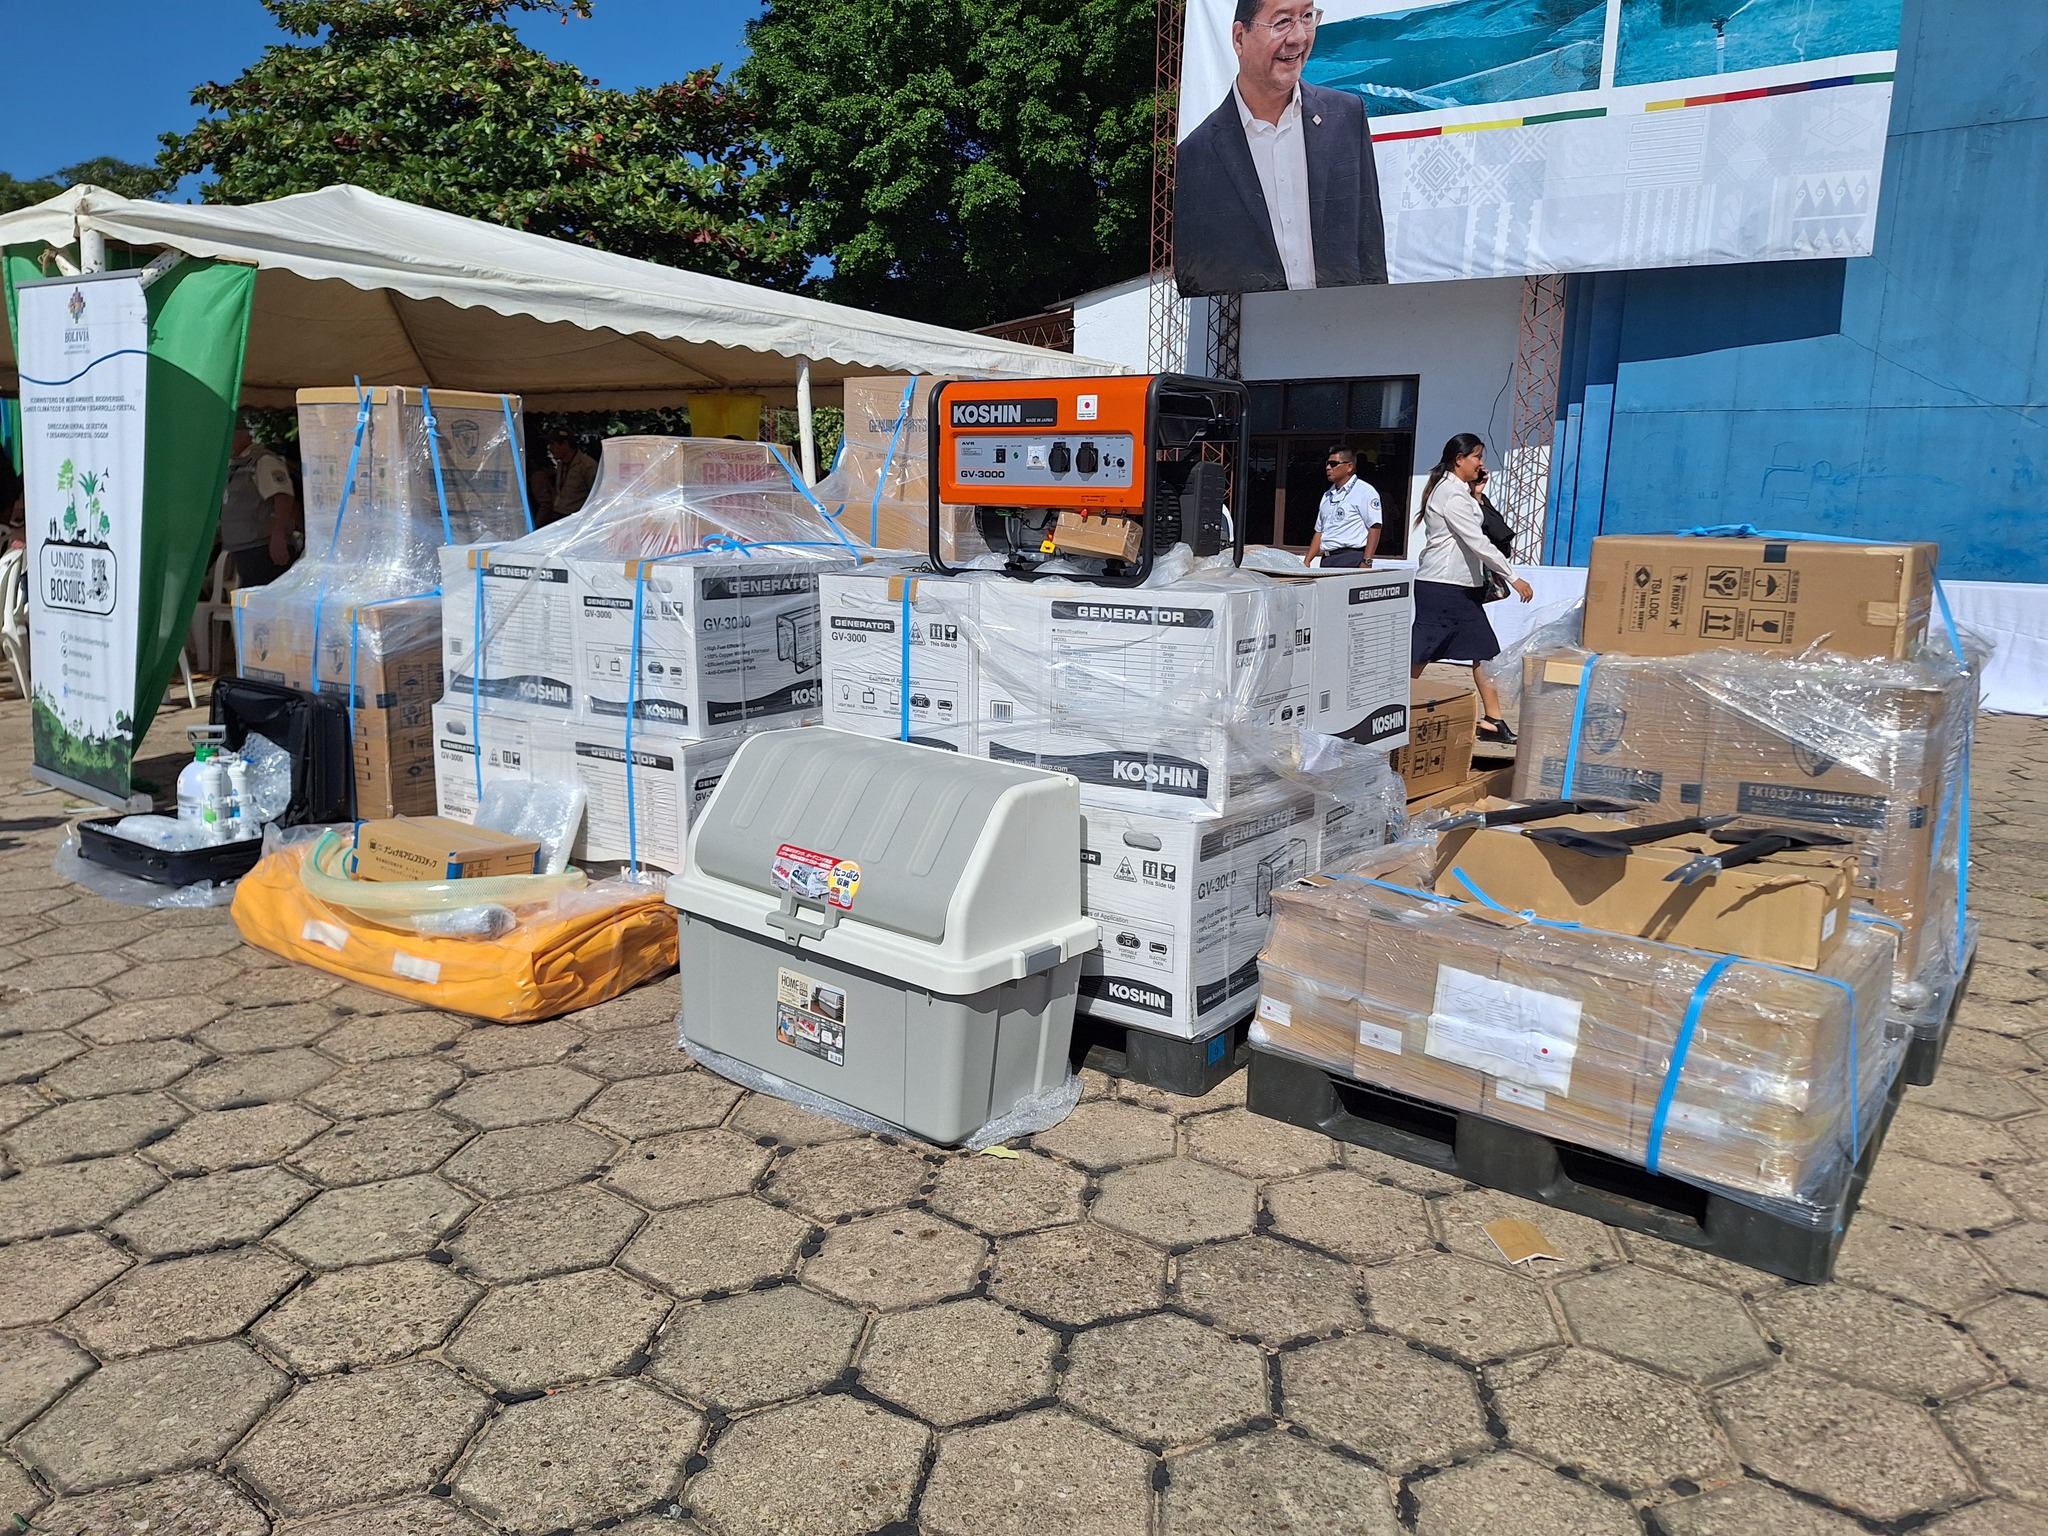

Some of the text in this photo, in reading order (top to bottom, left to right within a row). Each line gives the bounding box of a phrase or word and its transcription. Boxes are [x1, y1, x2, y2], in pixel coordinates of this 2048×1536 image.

[65, 331, 90, 343] BOLIVIA
[953, 404, 1022, 424] KOSHIN
[960, 470, 1006, 478] GV-3000
[51, 551, 84, 570] UNIDOS
[50, 578, 86, 605] BOSQUES
[728, 576, 819, 594] GENERATOR
[1358, 586, 1400, 600] GENERATOR
[1648, 578, 1662, 621] TSA LOCK
[1670, 584, 1682, 615] FK1037-1
[586, 598, 631, 608] GENERATOR
[584, 610, 612, 619] GV-3000
[1077, 606, 1185, 624] GENERATOR
[703, 616, 751, 630] GV-3000
[834, 618, 890, 630] GENERATOR
[832, 632, 866, 643] GV-3000
[520, 682, 568, 702] KOSHIN
[646, 704, 684, 720] KOSHIN
[714, 706, 765, 718] www.koshinmp.com
[1371, 710, 1404, 735] KOSHIN
[442, 743, 475, 754] GENERATO
[441, 752, 464, 762] GV-3000
[1112, 760, 1199, 789] KOSHIN
[444, 804, 472, 815] KOSHIN LTD.
[833, 866, 860, 882] たっぷり
[1142, 878, 1154, 886] This
[1214, 906, 1228, 914] Efficien
[1100, 913, 1129, 924] Application
[1149, 955, 1168, 963] ELECTRIC
[781, 974, 800, 990] HOME
[1108, 982, 1166, 1010] KOSHIN
